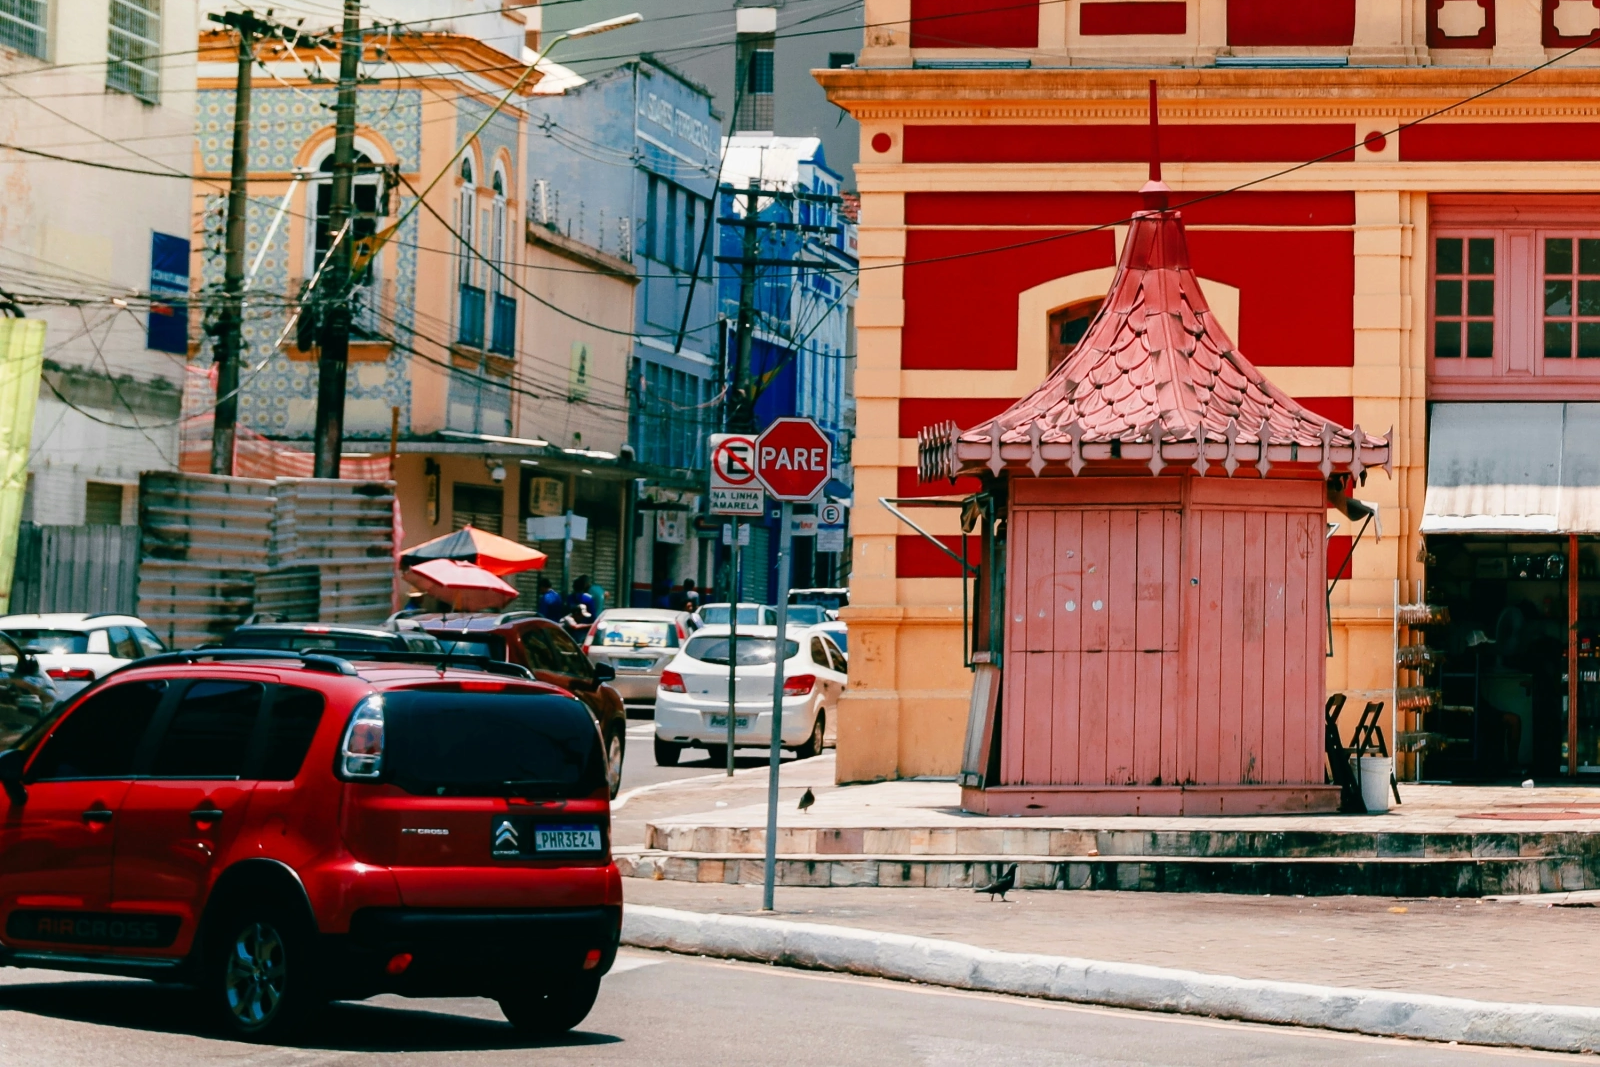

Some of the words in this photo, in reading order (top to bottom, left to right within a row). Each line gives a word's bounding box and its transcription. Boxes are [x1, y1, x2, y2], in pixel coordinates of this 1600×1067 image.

[727, 447, 749, 474] E
[761, 447, 824, 471] PARE
[713, 492, 726, 500] NA
[731, 492, 758, 500] LINHA
[713, 502, 758, 510] AMARELA
[826, 509, 835, 520] E
[542, 832, 595, 849] PHR3E24
[37, 917, 159, 940] AIRCROSS
